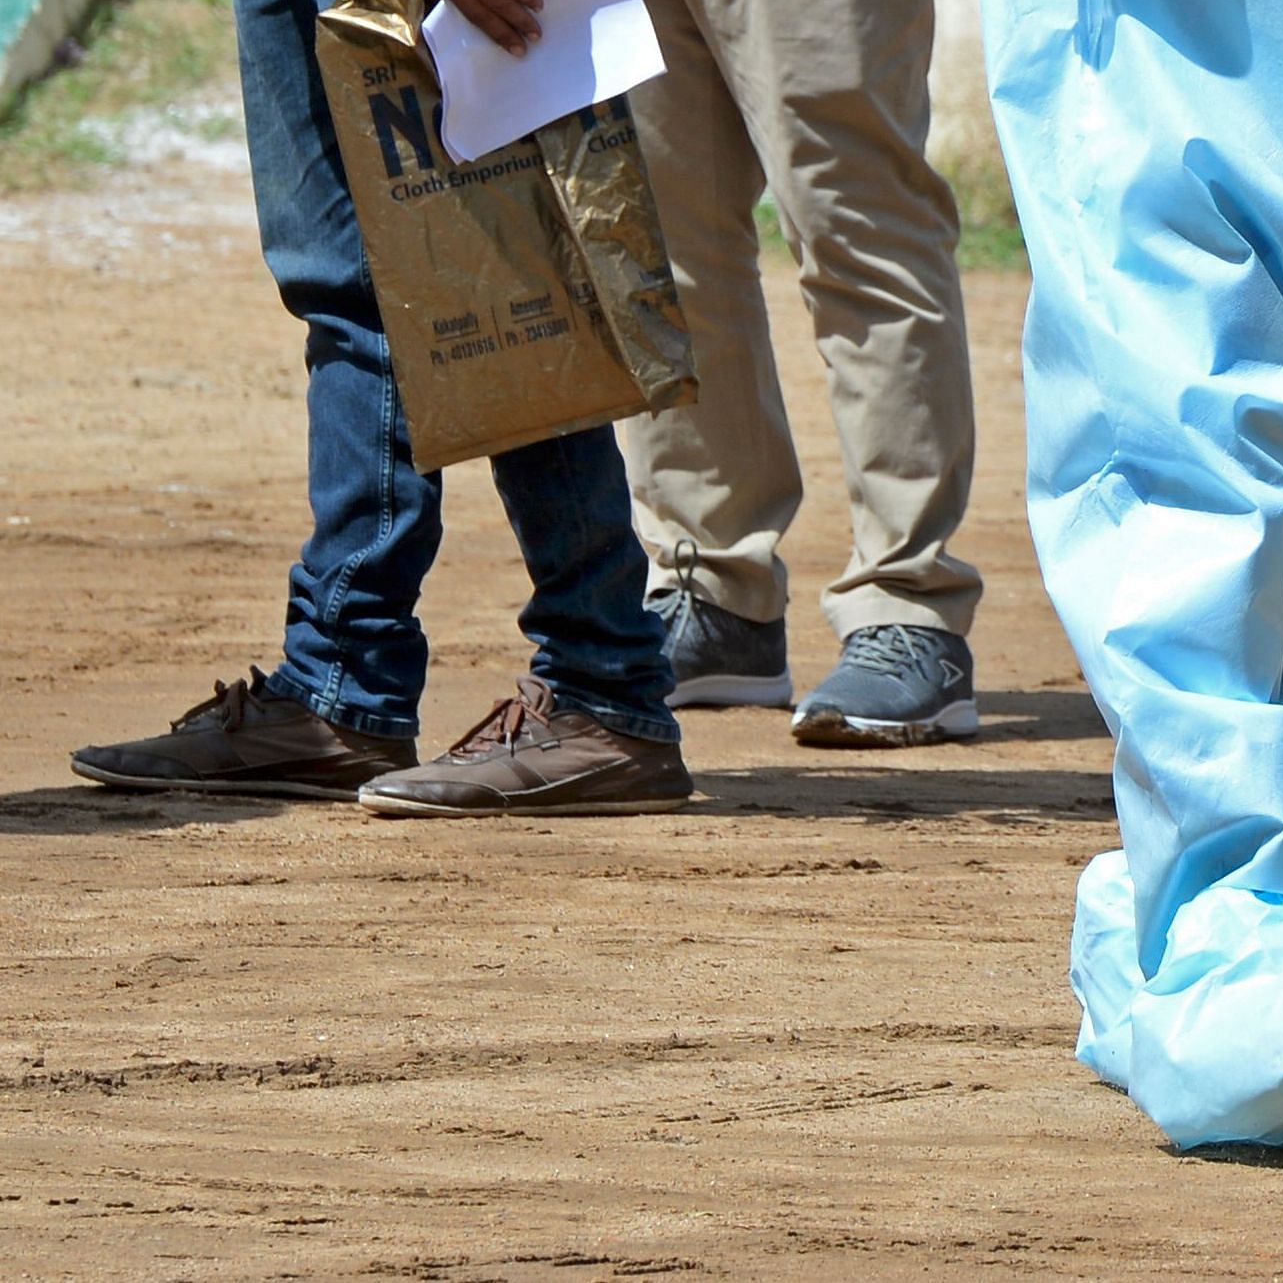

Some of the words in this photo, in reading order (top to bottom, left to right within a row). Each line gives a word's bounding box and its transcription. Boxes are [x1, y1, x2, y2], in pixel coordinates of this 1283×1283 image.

[363, 64, 398, 88] SRI
[588, 125, 638, 154] Cloth
[390, 175, 442, 203] Cloth
